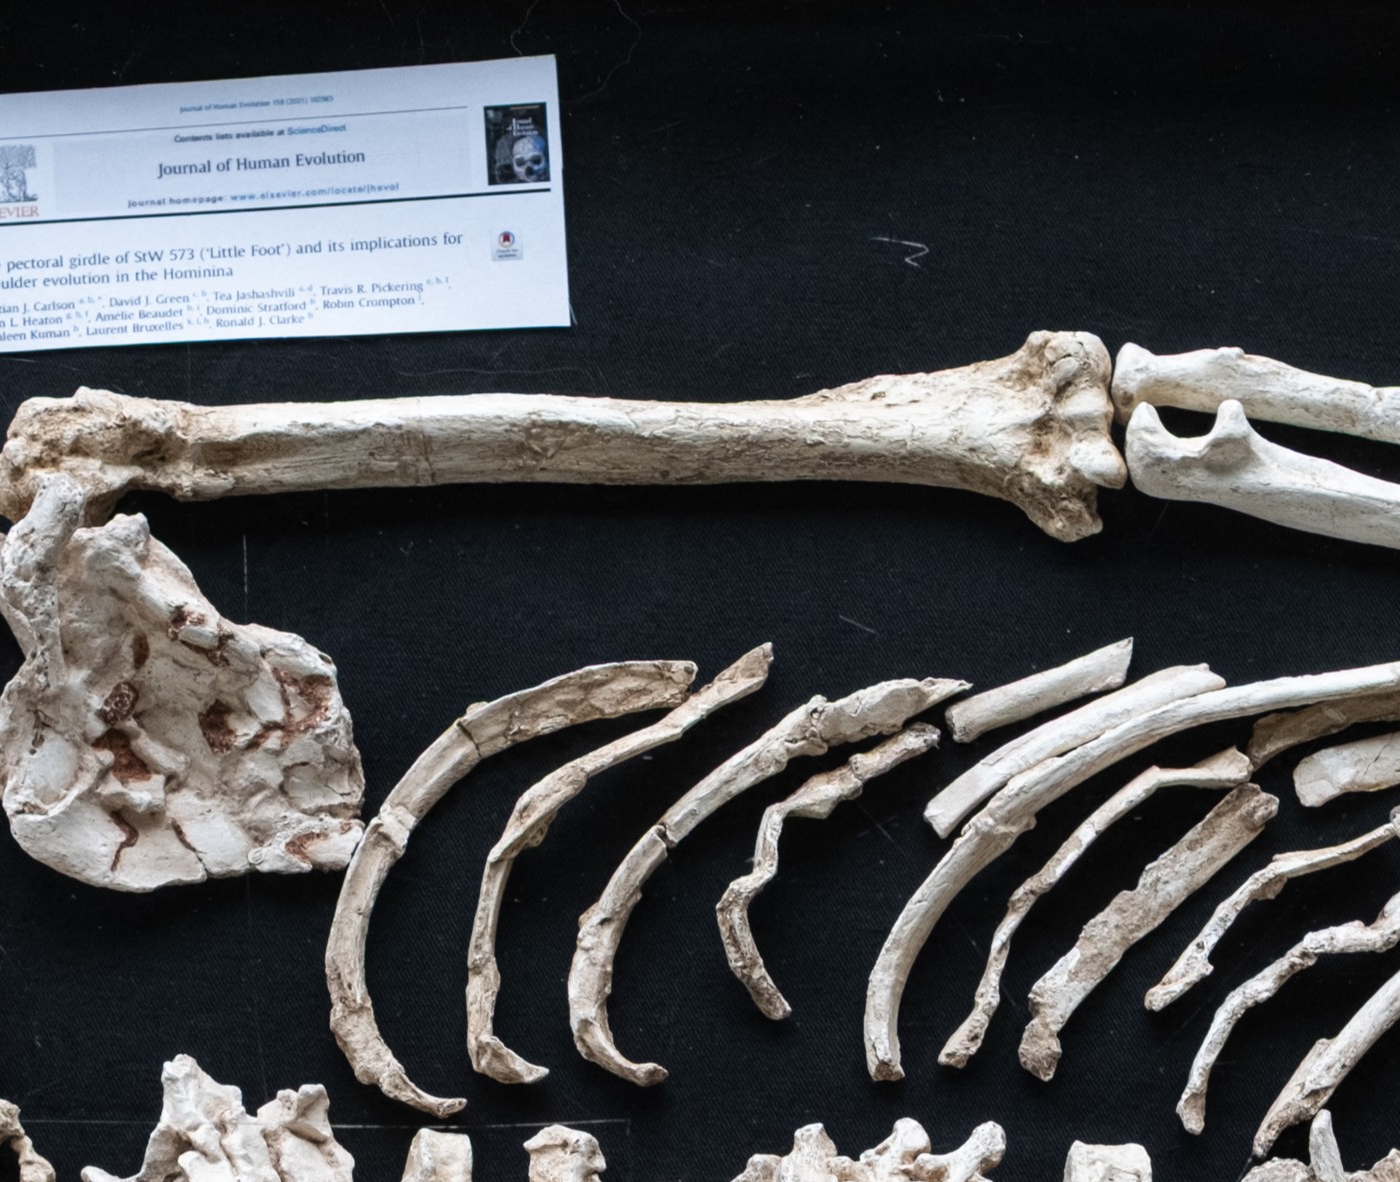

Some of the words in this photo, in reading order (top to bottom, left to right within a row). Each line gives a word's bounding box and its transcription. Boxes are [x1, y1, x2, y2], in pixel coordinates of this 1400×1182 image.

[158, 161, 211, 182] Journal
[216, 159, 232, 174] of
[236, 156, 290, 172] Human
[296, 151, 365, 169] Evolution
[7, 255, 63, 273] pectoral
[69, 252, 110, 270] girdle
[115, 251, 130, 265] of
[134, 249, 164, 263] StW
[170, 248, 194, 261] 573
[200, 245, 245, 262] ('Little
[251, 242, 291, 258] Foot')
[296, 240, 322, 254] and
[328, 239, 345, 252] its
[351, 234, 437, 253] implications
[443, 232, 463, 246] for
[43, 271, 110, 288] evolution
[116, 270, 129, 283] in
[135, 269, 158, 282] the
[164, 264, 233, 281] Hominina
